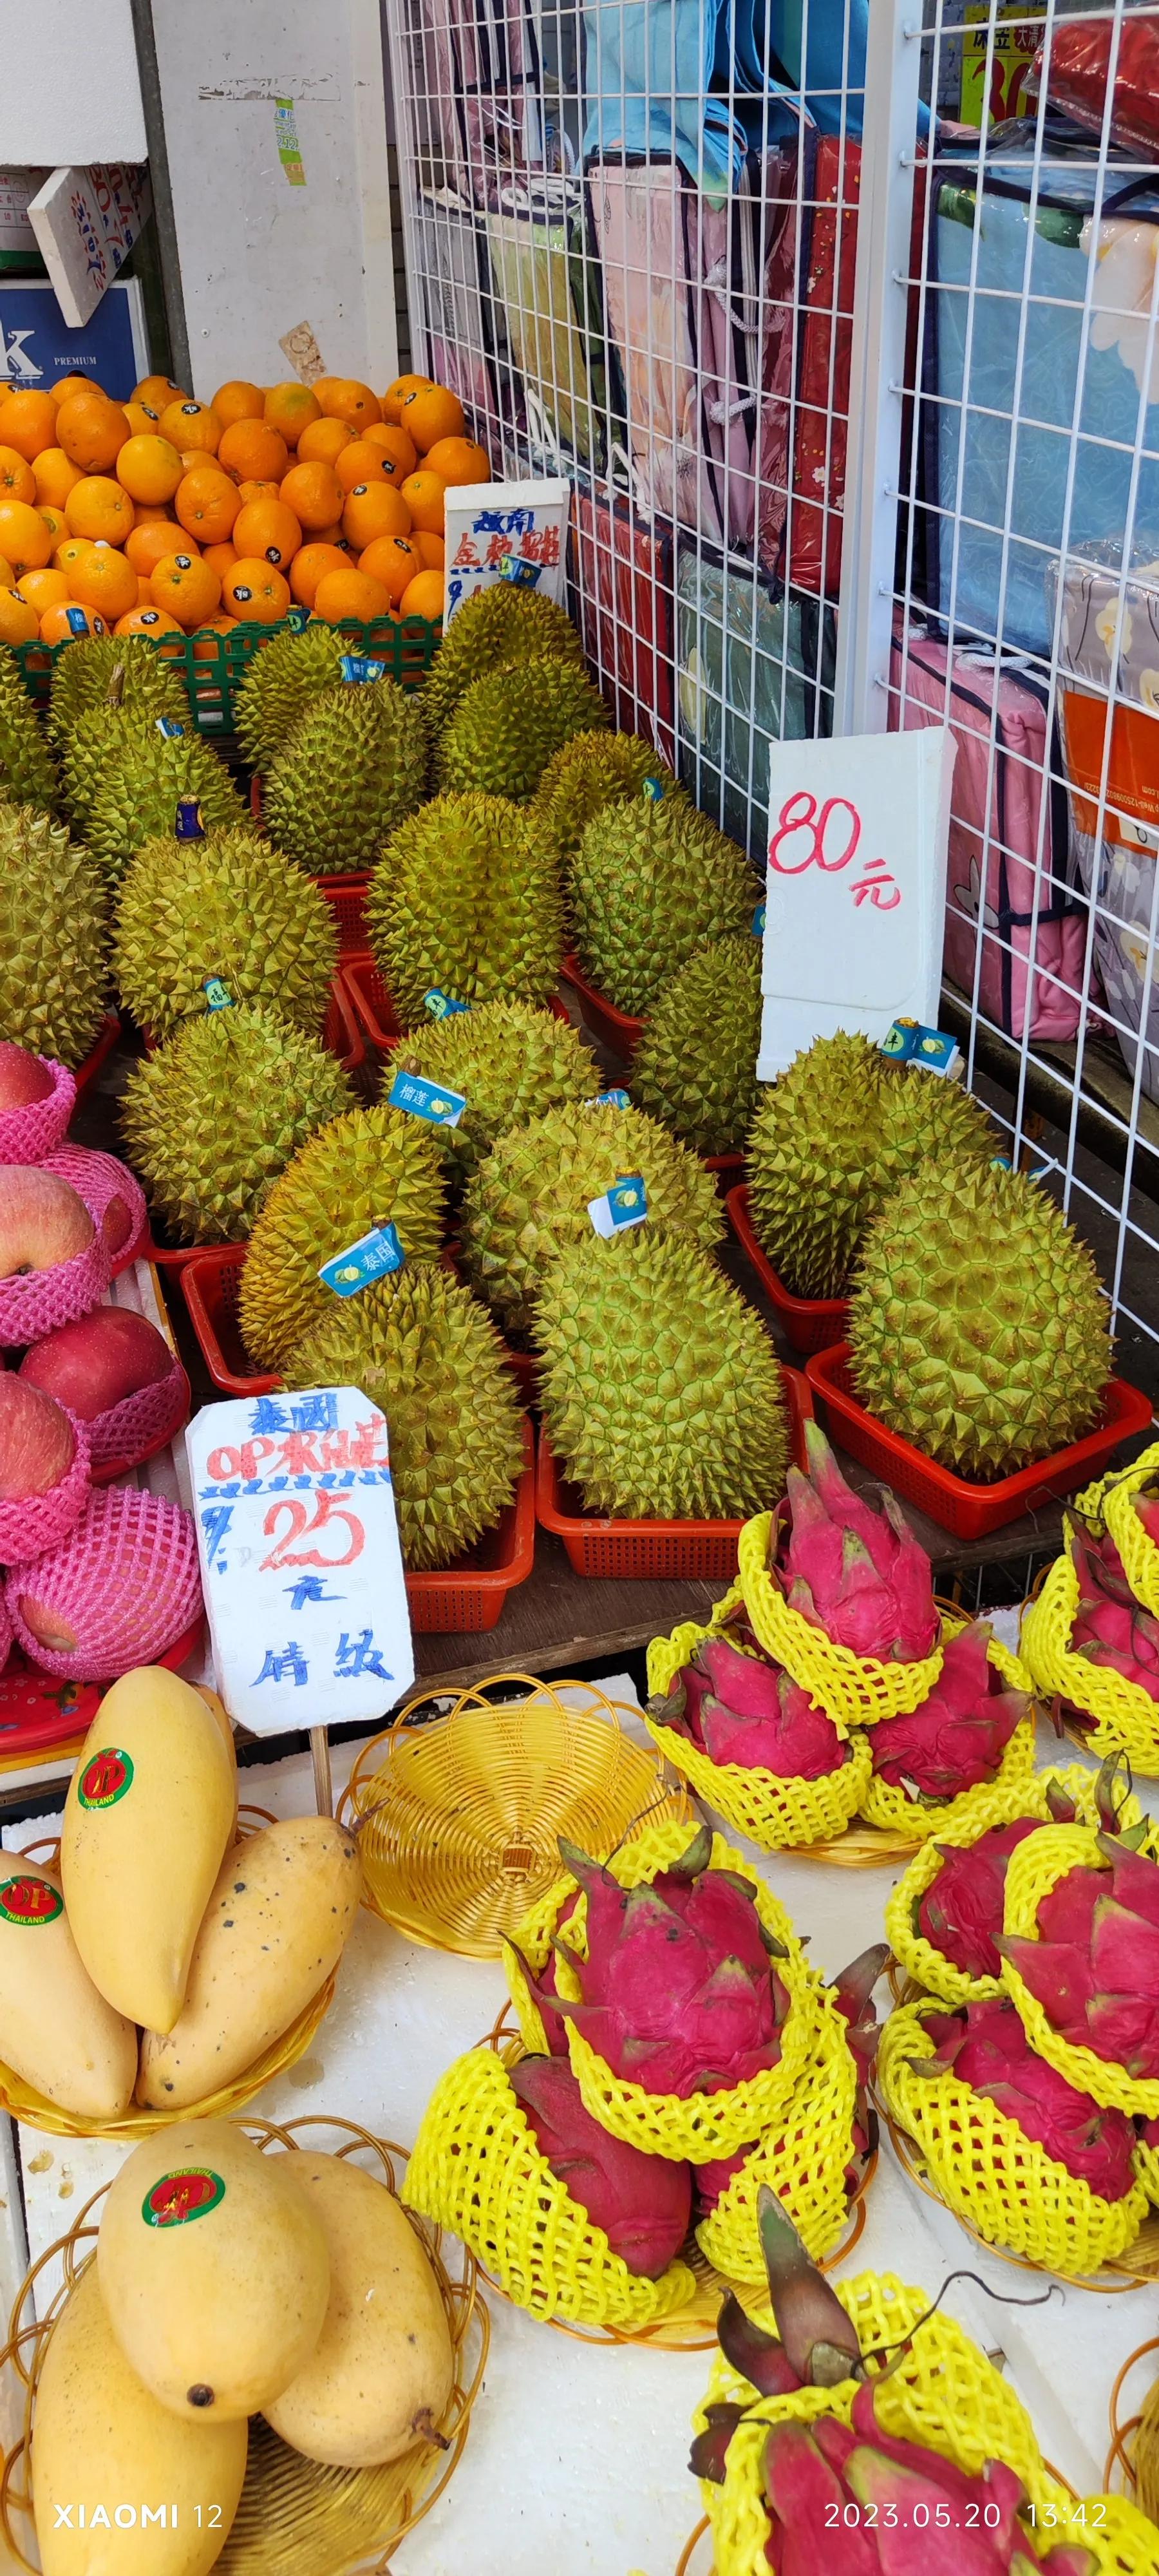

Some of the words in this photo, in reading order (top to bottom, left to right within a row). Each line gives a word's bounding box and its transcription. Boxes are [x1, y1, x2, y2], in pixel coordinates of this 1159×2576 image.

[54, 356, 97, 366] PREMIUM
[768, 791, 861, 875] 80
[849, 858, 901, 911] 元
[399, 1083, 429, 1107] 榴莲
[361, 1240, 395, 1271] 泰国
[258, 1489, 366, 1573] 25
[282, 1575, 348, 1610] 元
[84, 1794, 115, 1807] THAILAND
[7, 1884, 52, 1909] OP
[5, 1911, 46, 1924] THAILAND
[167, 2168, 214, 2179] THAILAND
